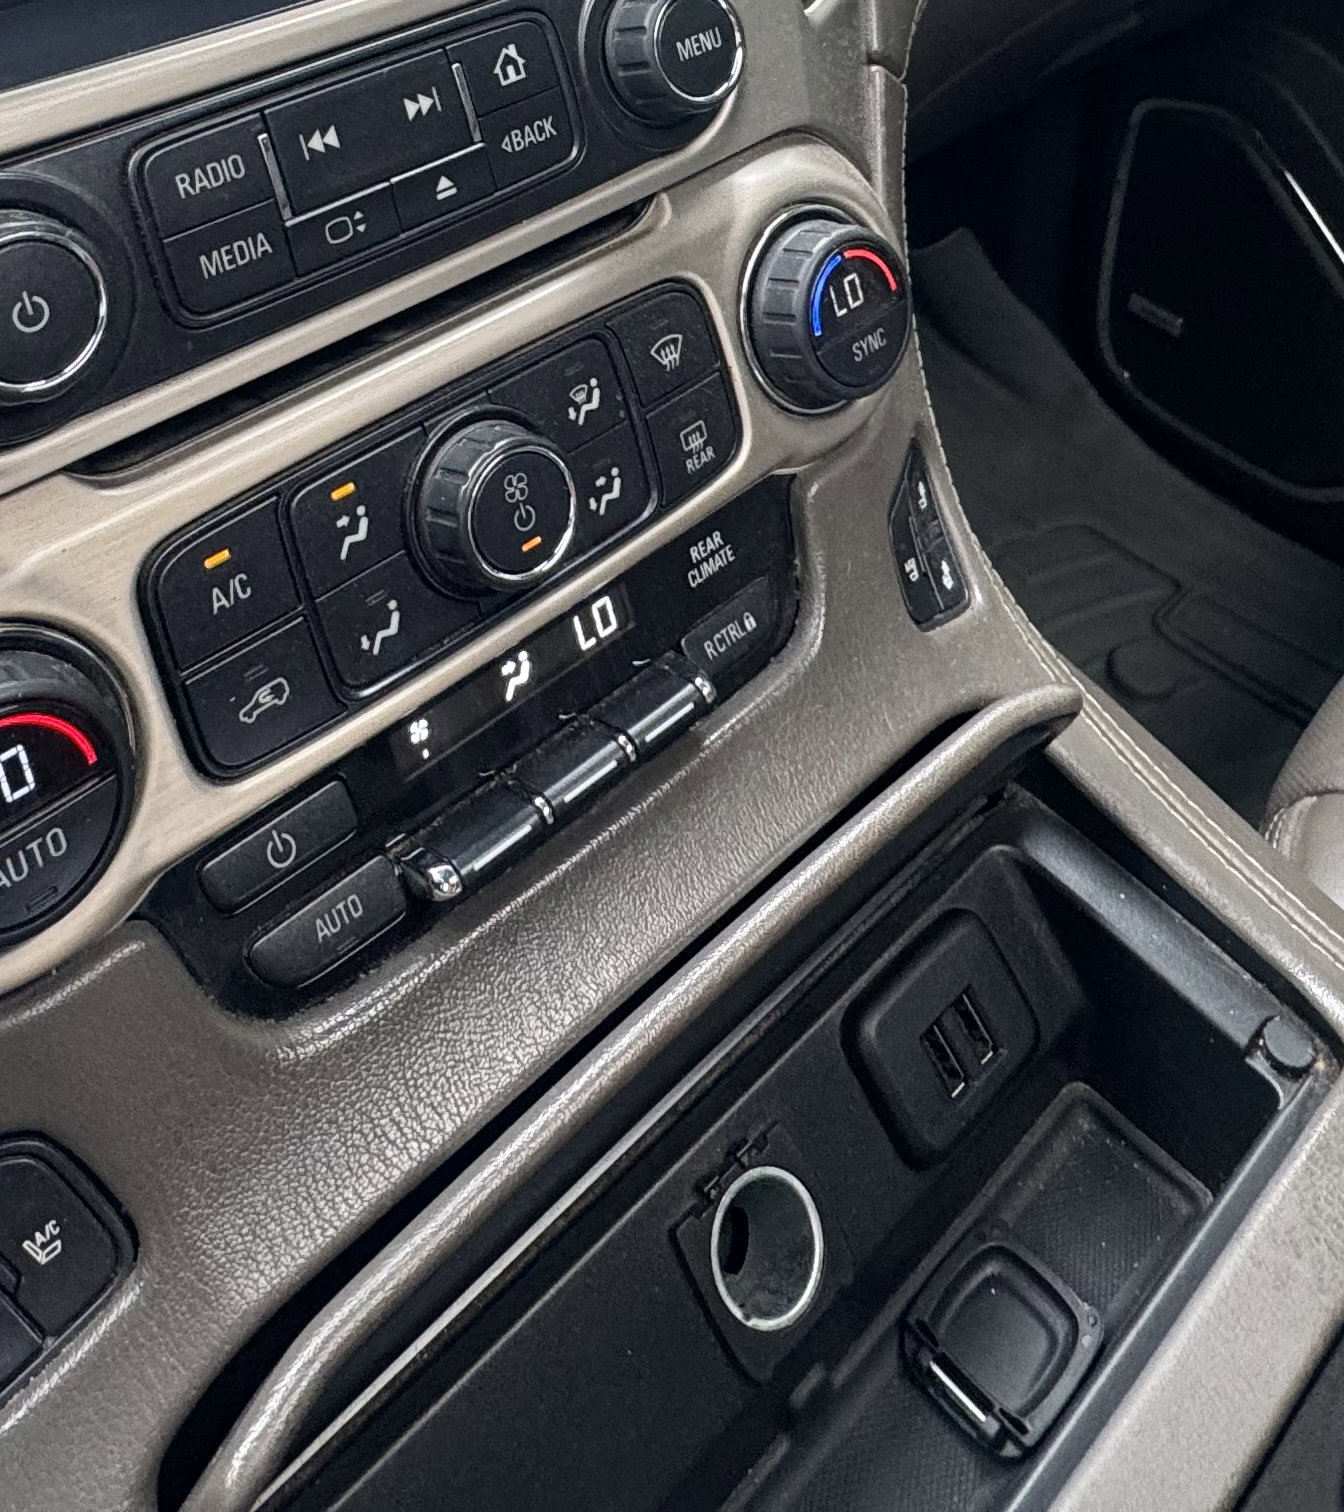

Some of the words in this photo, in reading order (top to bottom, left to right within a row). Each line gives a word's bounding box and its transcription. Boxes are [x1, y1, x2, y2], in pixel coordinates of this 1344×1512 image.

[675, 26, 723, 61] MENU
[511, 115, 557, 154] BACK
[174, 153, 246, 199] RADIO
[199, 232, 273, 279] MEDIA
[829, 273, 865, 317] LO
[852, 327, 887, 361] SYNC
[685, 445, 716, 474] REAR
[687, 544, 735, 588] CLIMATE
[689, 530, 724, 563] REAR
[210, 572, 252, 615] A/C
[573, 595, 618, 651] LO
[314, 894, 364, 942] AUTO
[35, 1219, 60, 1246] A/C
